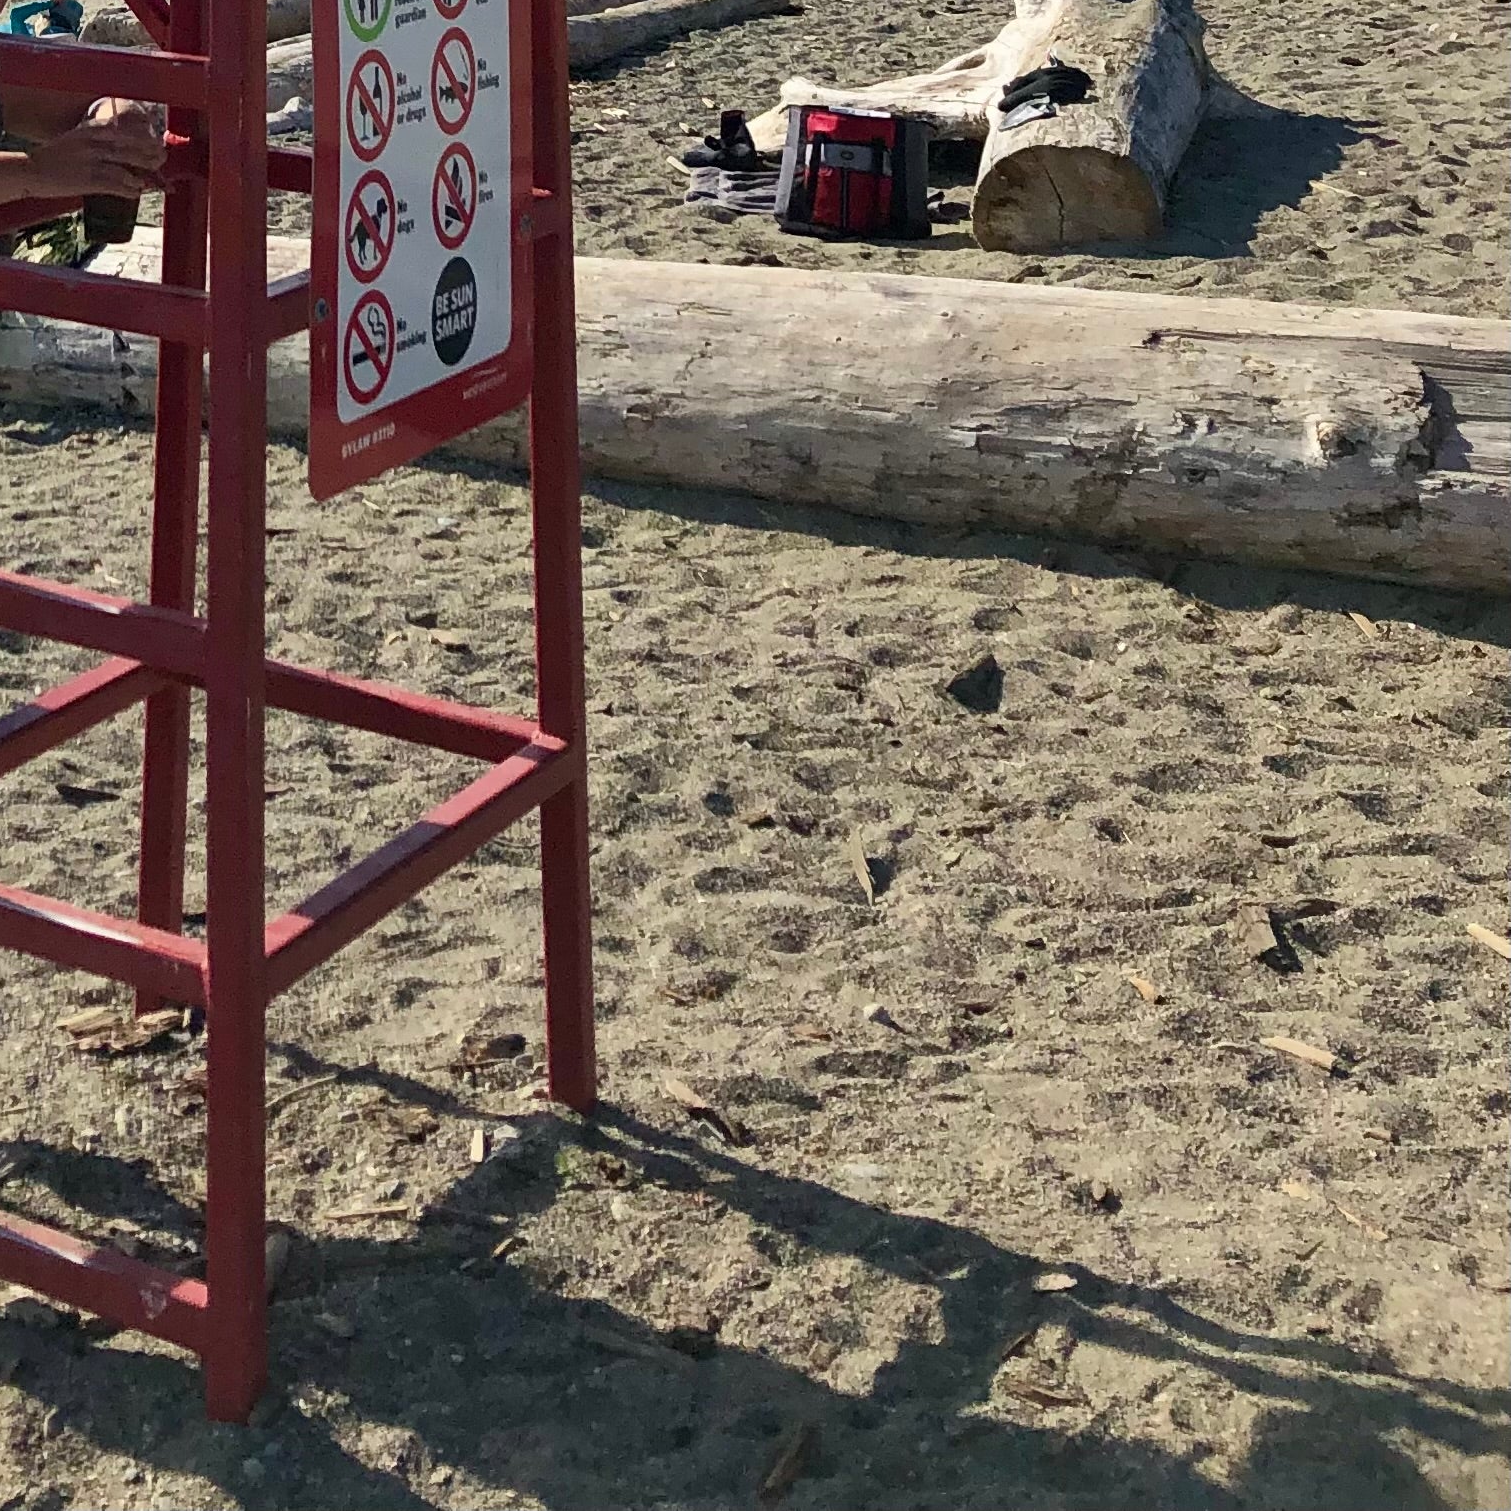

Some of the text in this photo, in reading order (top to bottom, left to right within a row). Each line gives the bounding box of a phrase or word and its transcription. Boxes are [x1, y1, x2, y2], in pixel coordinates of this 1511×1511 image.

[395, 7, 426, 29] guardian
[478, 58, 486, 71] No
[397, 72, 407, 86] No
[478, 74, 499, 90] fishing
[397, 85, 422, 105] alcohol
[397, 107, 426, 124] or drugs
[479, 170, 488, 186] No
[479, 189, 493, 204] fires
[397, 199, 407, 215] No
[397, 219, 414, 234] dogs
[436, 282, 473, 317] BE SUN
[397, 318, 407, 334] No
[435, 306, 474, 341] SMART
[397, 330, 427, 353] smoking
